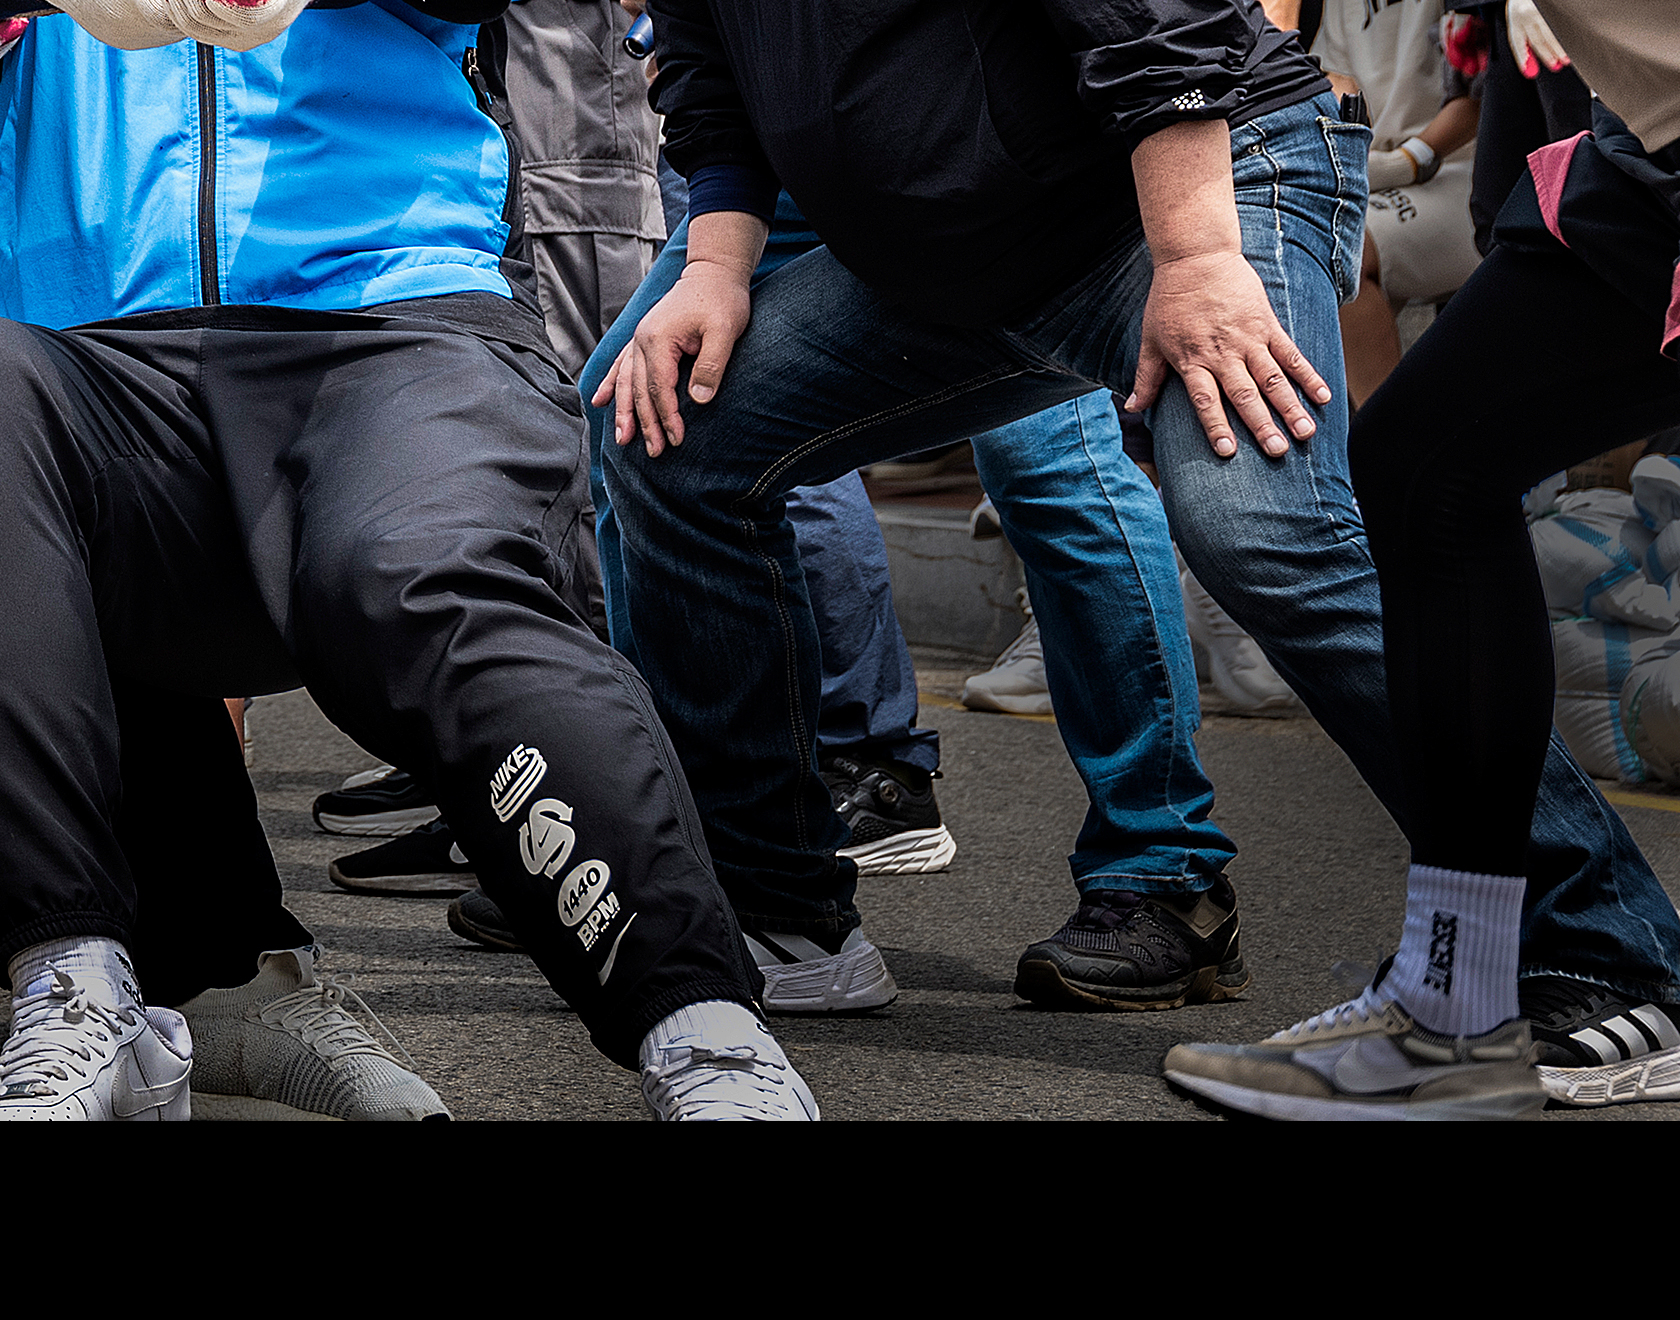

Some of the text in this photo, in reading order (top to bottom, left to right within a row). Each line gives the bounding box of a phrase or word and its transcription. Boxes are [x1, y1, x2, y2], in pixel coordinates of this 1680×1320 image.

[490, 743, 530, 800] NIKE
[563, 866, 602, 920] 1440
[577, 891, 620, 948] BPM
